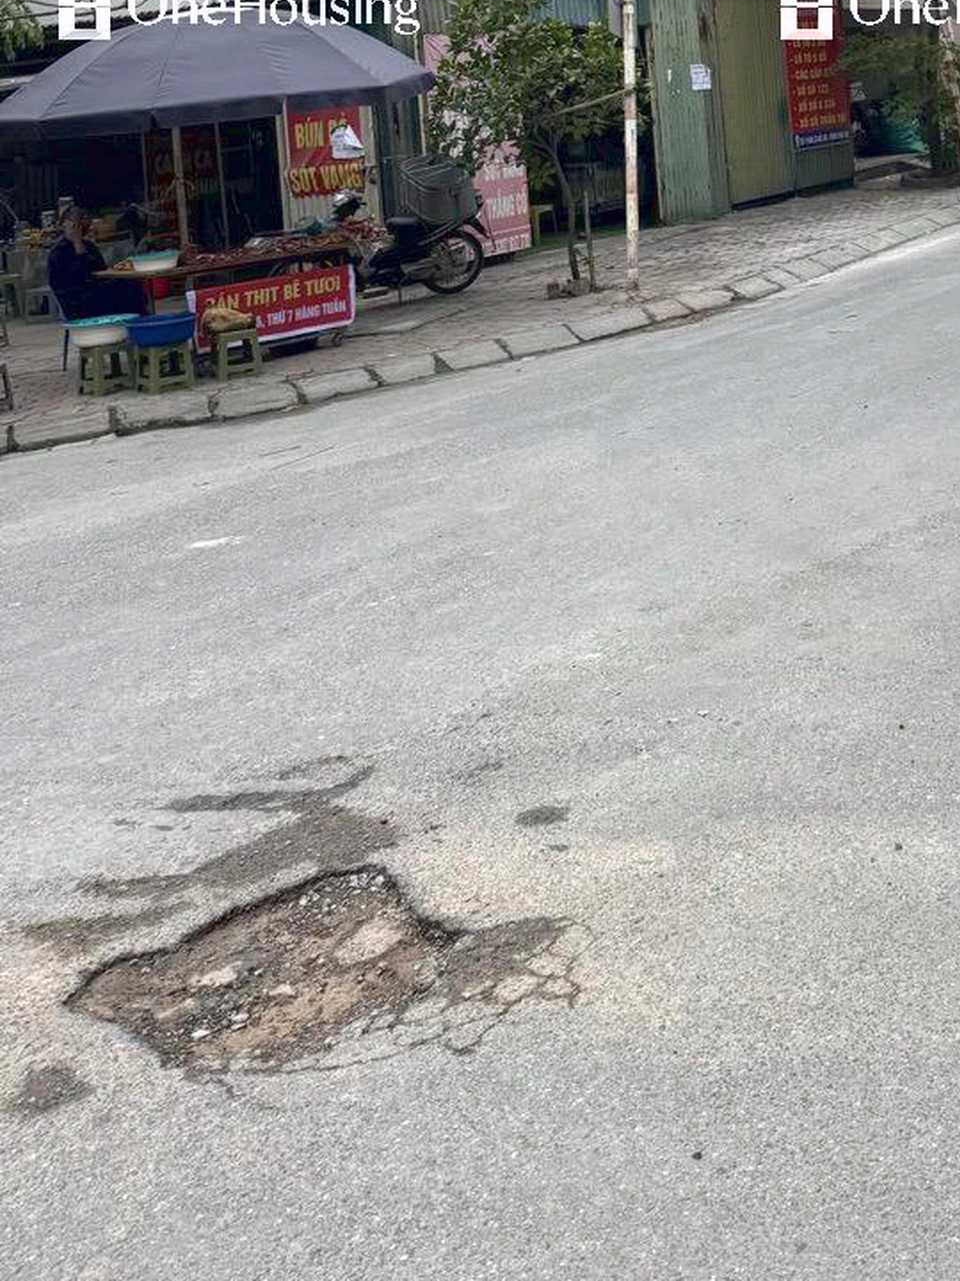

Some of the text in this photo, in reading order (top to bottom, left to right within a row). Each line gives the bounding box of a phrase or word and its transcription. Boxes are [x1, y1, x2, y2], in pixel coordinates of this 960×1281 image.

[295, 116, 325, 150] BÚN
[319, 162, 364, 190] VANG
[245, 286, 280, 307] THỊT
